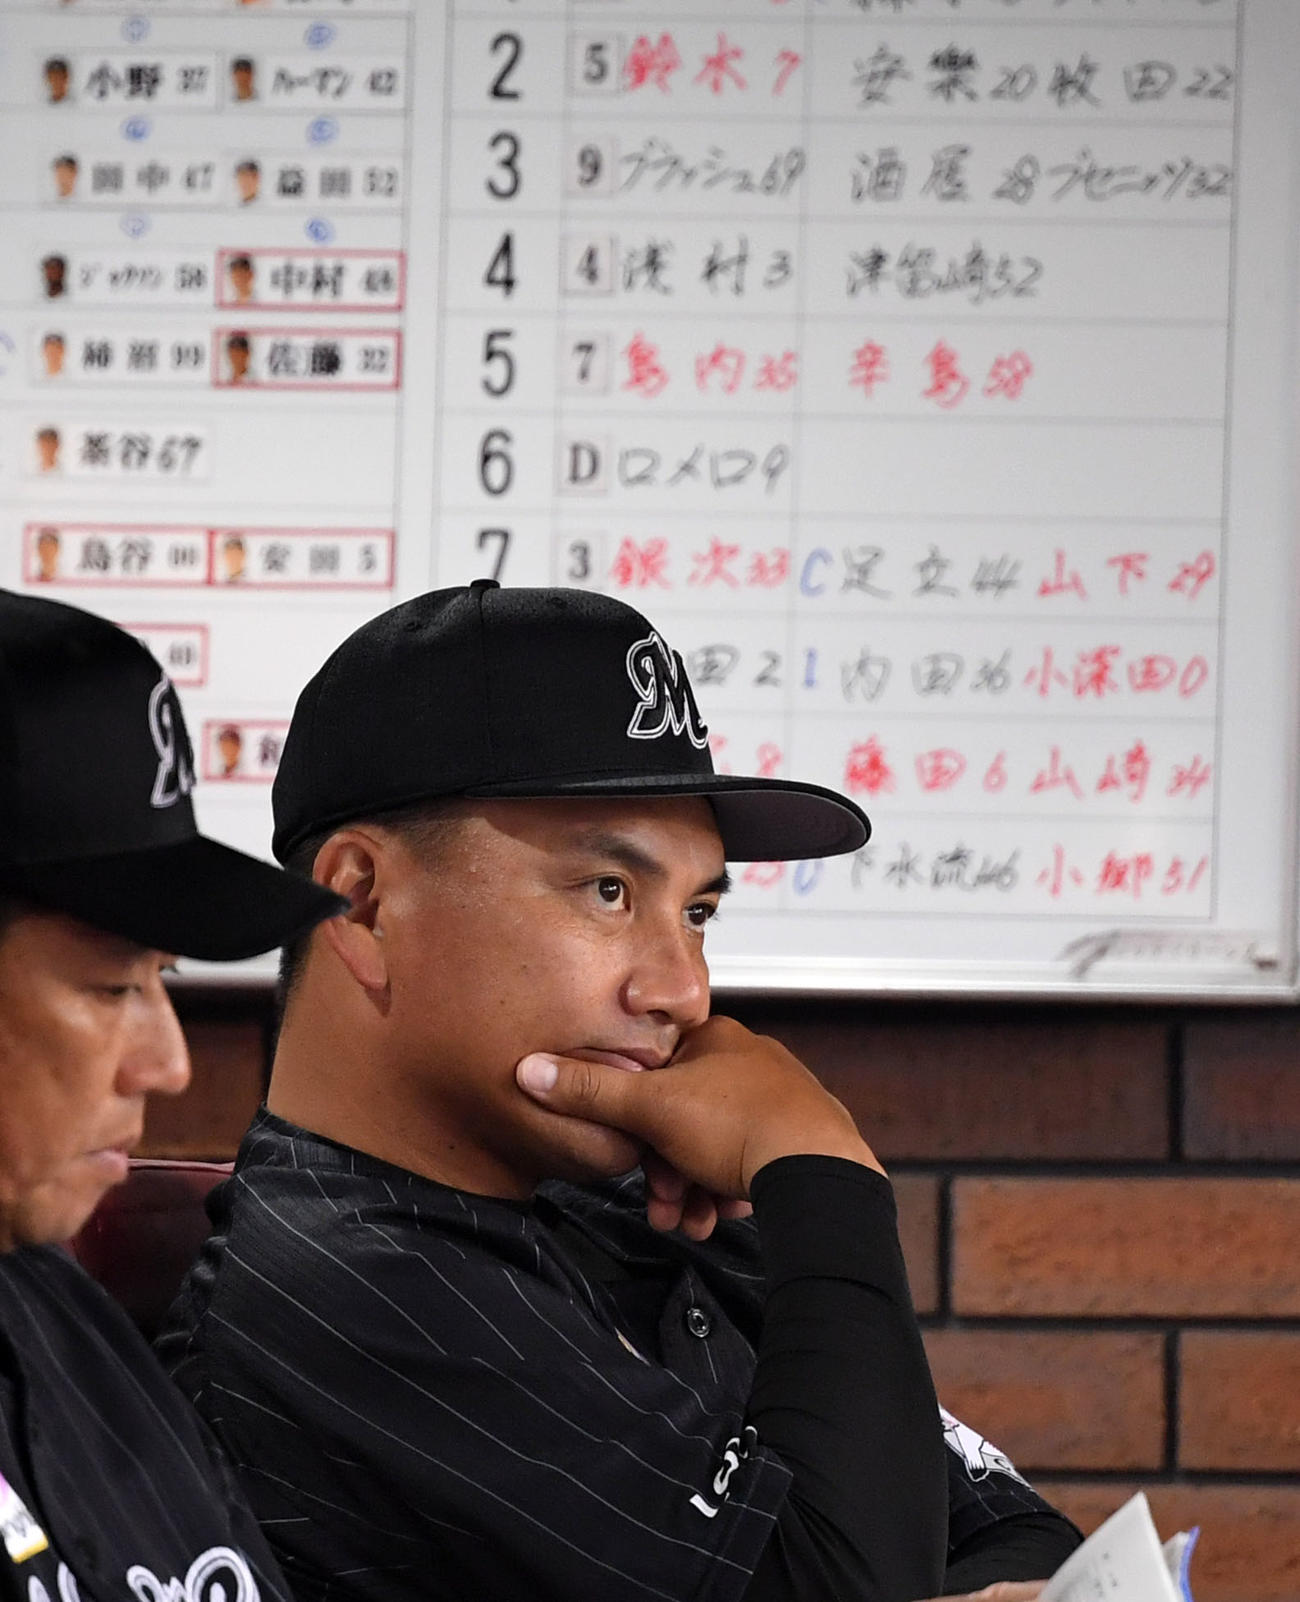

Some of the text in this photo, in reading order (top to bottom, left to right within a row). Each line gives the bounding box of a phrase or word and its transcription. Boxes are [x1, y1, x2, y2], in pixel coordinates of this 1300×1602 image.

[86, 63, 163, 99] 小野
[488, 30, 524, 102] 2
[584, 41, 609, 84] 5
[770, 46, 804, 98] 7
[989, 64, 1038, 102] 20
[1182, 59, 1239, 103] 22
[485, 130, 523, 202] 3
[578, 144, 603, 188] 9
[992, 153, 1042, 205] 28
[484, 232, 516, 297] 4
[578, 245, 600, 285] 4
[762, 250, 795, 289] 3
[482, 328, 516, 399] 5
[573, 340, 596, 382] 7
[155, 435, 203, 473] 67
[478, 428, 514, 498] 6
[568, 442, 601, 485] D
[761, 443, 794, 493] 9
[358, 543, 377, 574] 5
[476, 526, 512, 582] 7
[568, 541, 592, 580] 3
[798, 545, 834, 600] C
[970, 554, 1021, 599] 44
[1166, 548, 1218, 602] 29
[626, 631, 709, 749] M
[752, 648, 784, 690] 2
[1178, 652, 1210, 698] 0
[982, 750, 1008, 794] 6
